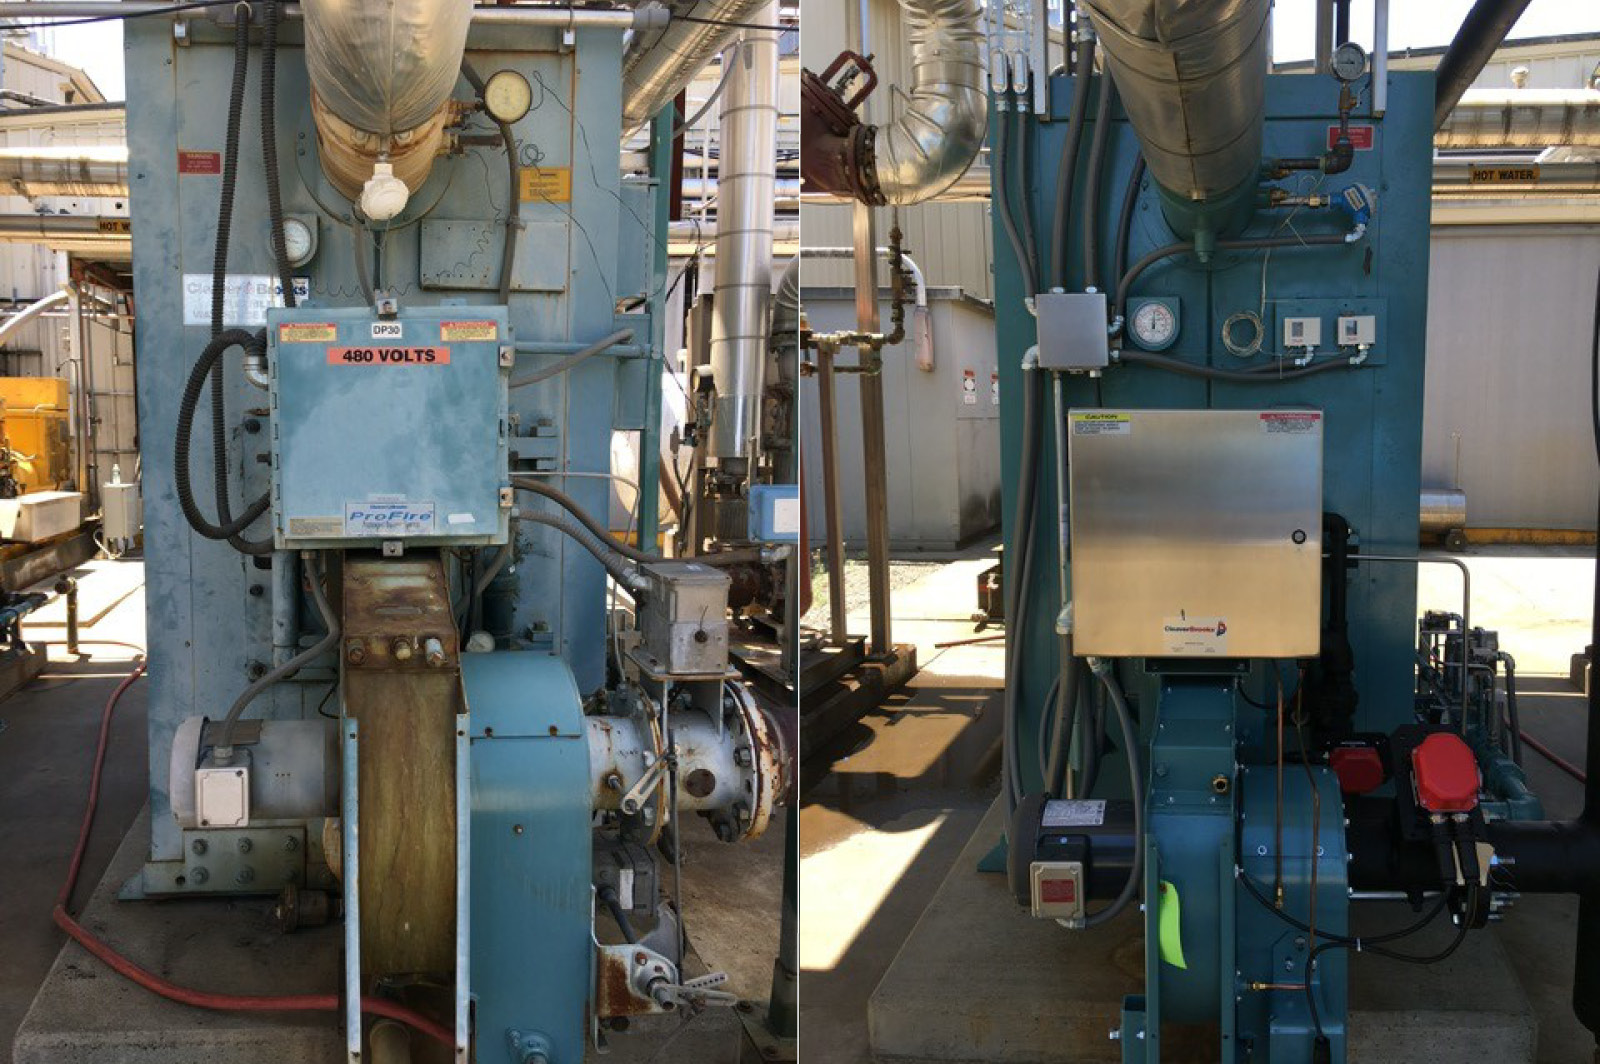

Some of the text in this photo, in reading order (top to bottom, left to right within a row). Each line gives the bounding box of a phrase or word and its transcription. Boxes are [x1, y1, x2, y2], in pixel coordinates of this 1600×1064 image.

[1473, 170, 1495, 180] HOT
[100, 221, 118, 231] HOT
[373, 325, 400, 335] DP30
[343, 349, 435, 362] 480 VOLTS
[349, 511, 431, 521] ProFire
